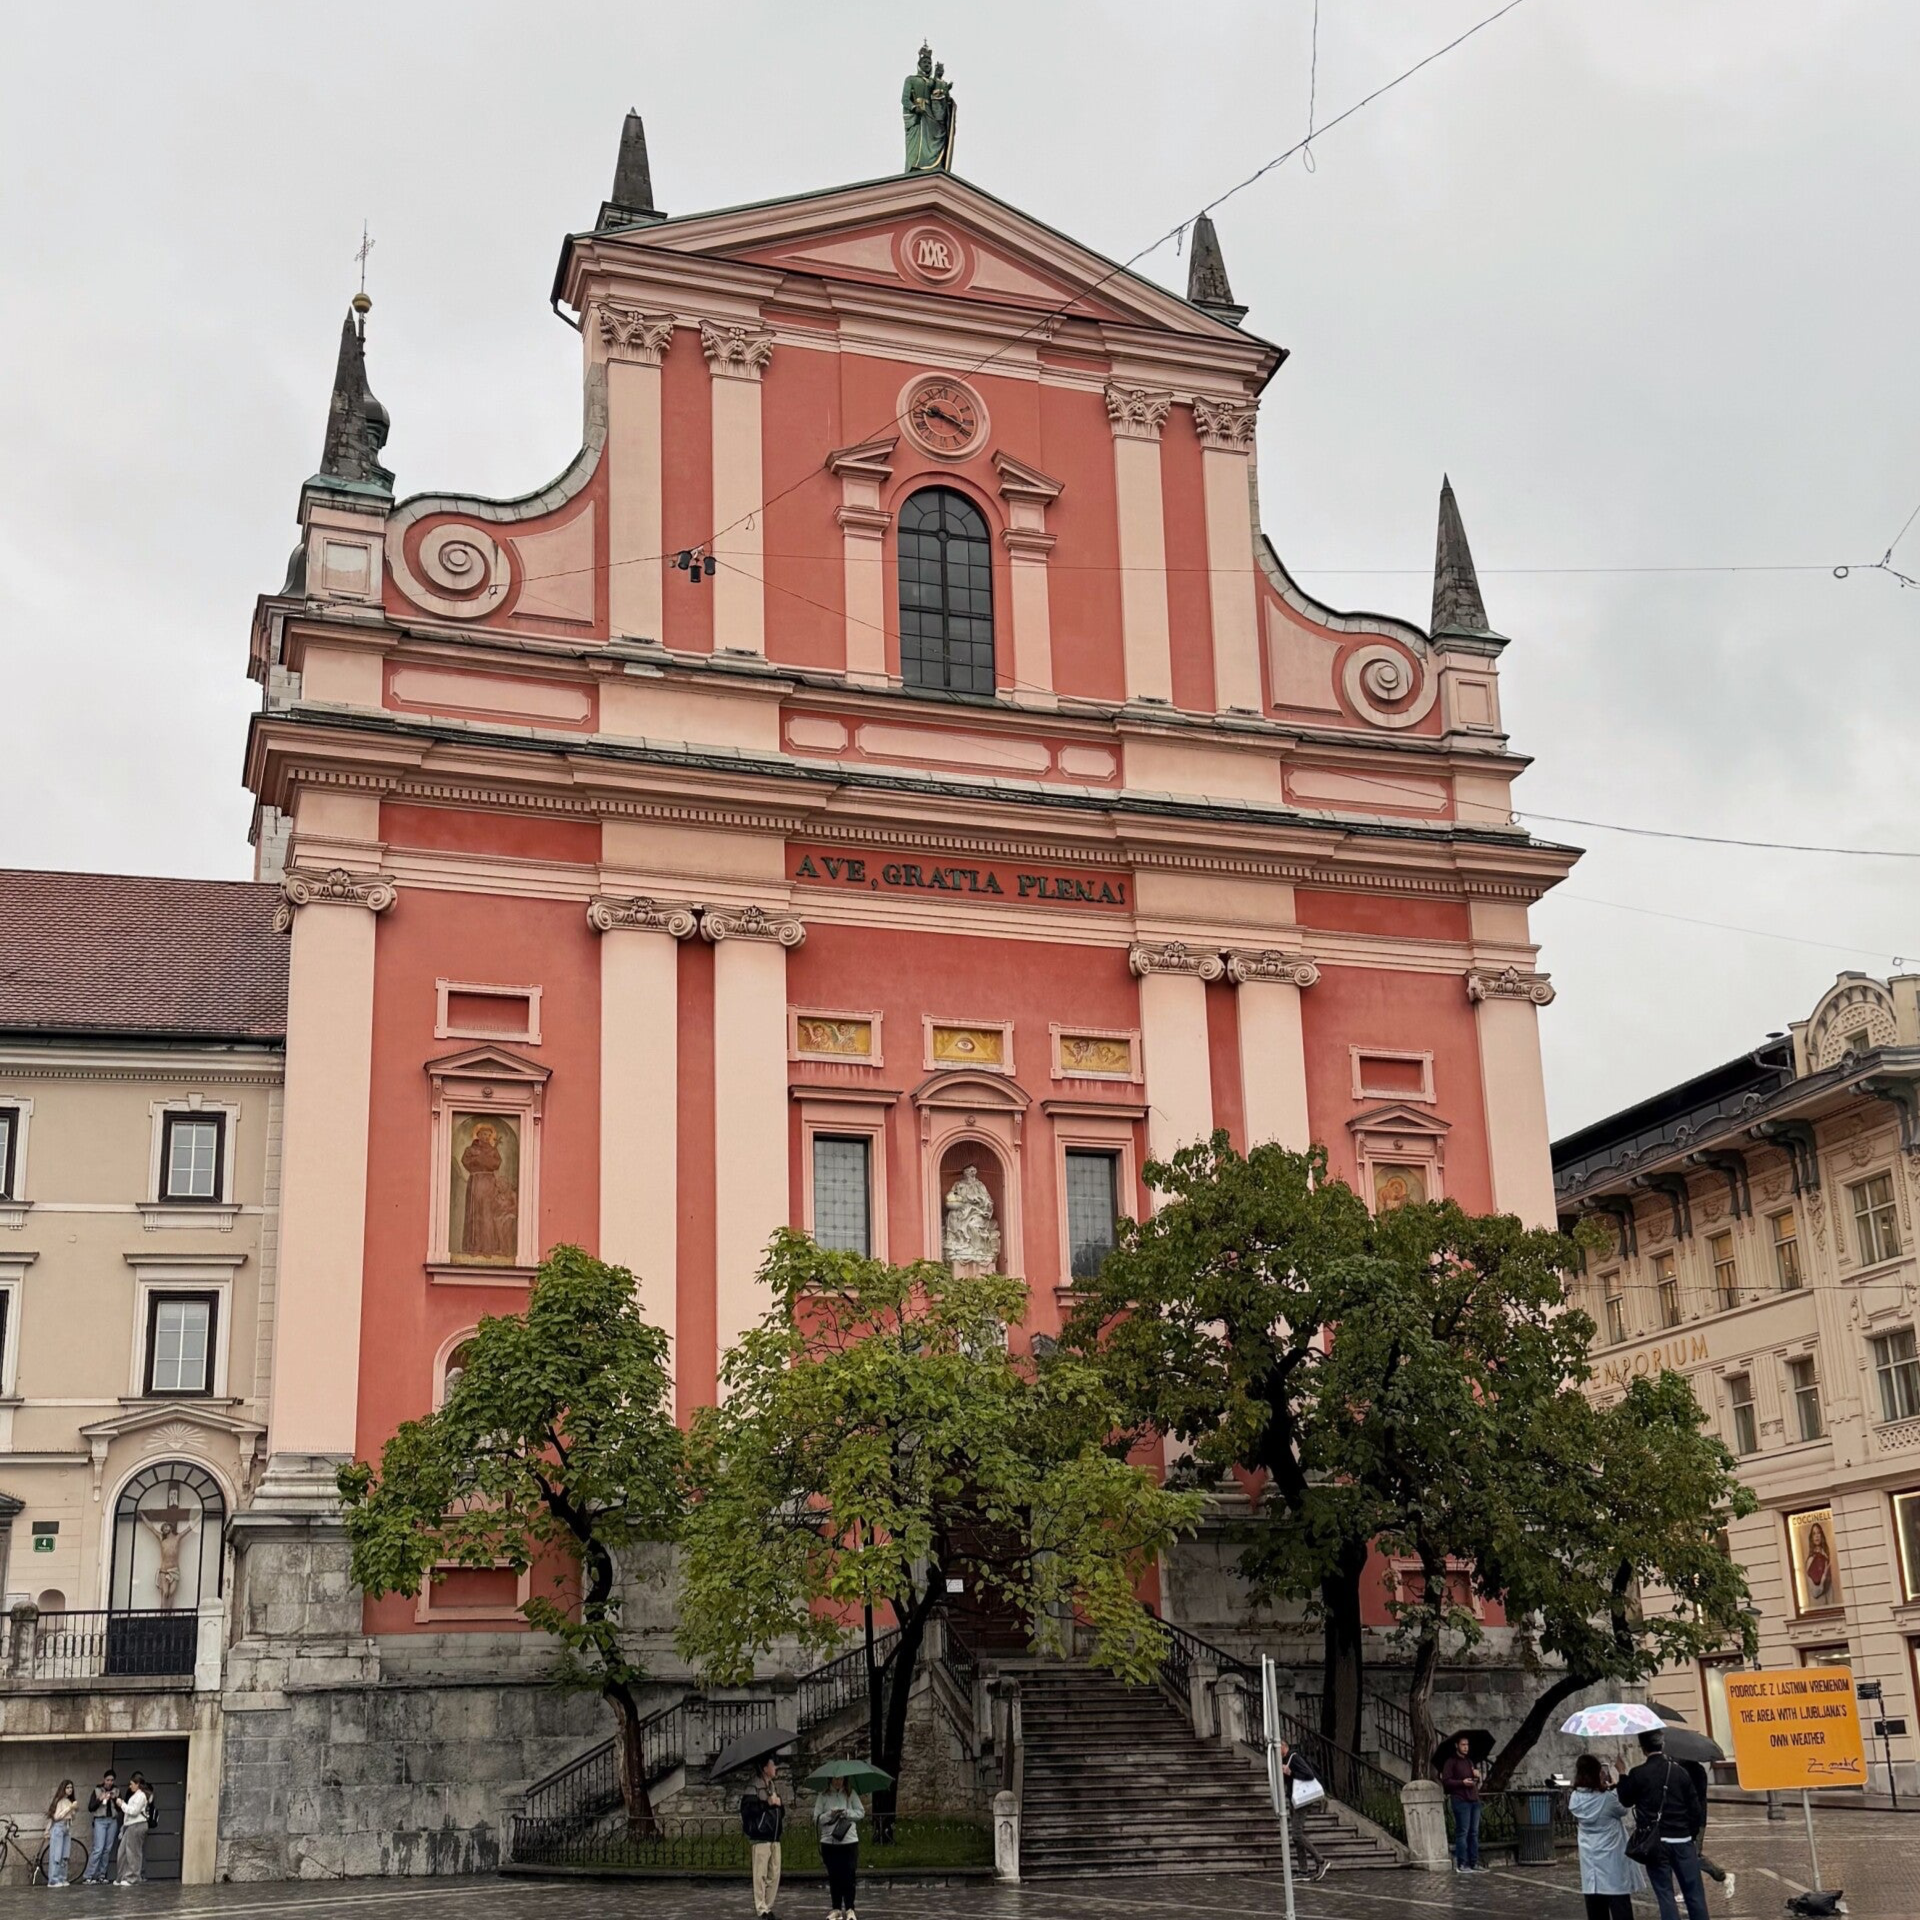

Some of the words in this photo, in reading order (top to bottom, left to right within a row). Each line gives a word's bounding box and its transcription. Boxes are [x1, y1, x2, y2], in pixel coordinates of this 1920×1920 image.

[882, 864, 1004, 894] GRATIA
[1017, 874, 1126, 905] PLENA!
[1592, 1334, 1709, 1390] EMPORIUM
[1769, 1682, 1775, 1696] Z
[1776, 1681, 1807, 1696] LASTNIM
[1809, 1679, 1850, 1693] VREMENOM
[1740, 1710, 1755, 1723] THE
[1757, 1708, 1775, 1722] AREA
[1777, 1707, 1797, 1720] WITH
[1799, 1704, 1847, 1720] LJUBLJANA'S
[1770, 1733, 1788, 1748] OWN
[1790, 1731, 1826, 1746] WEATHER
